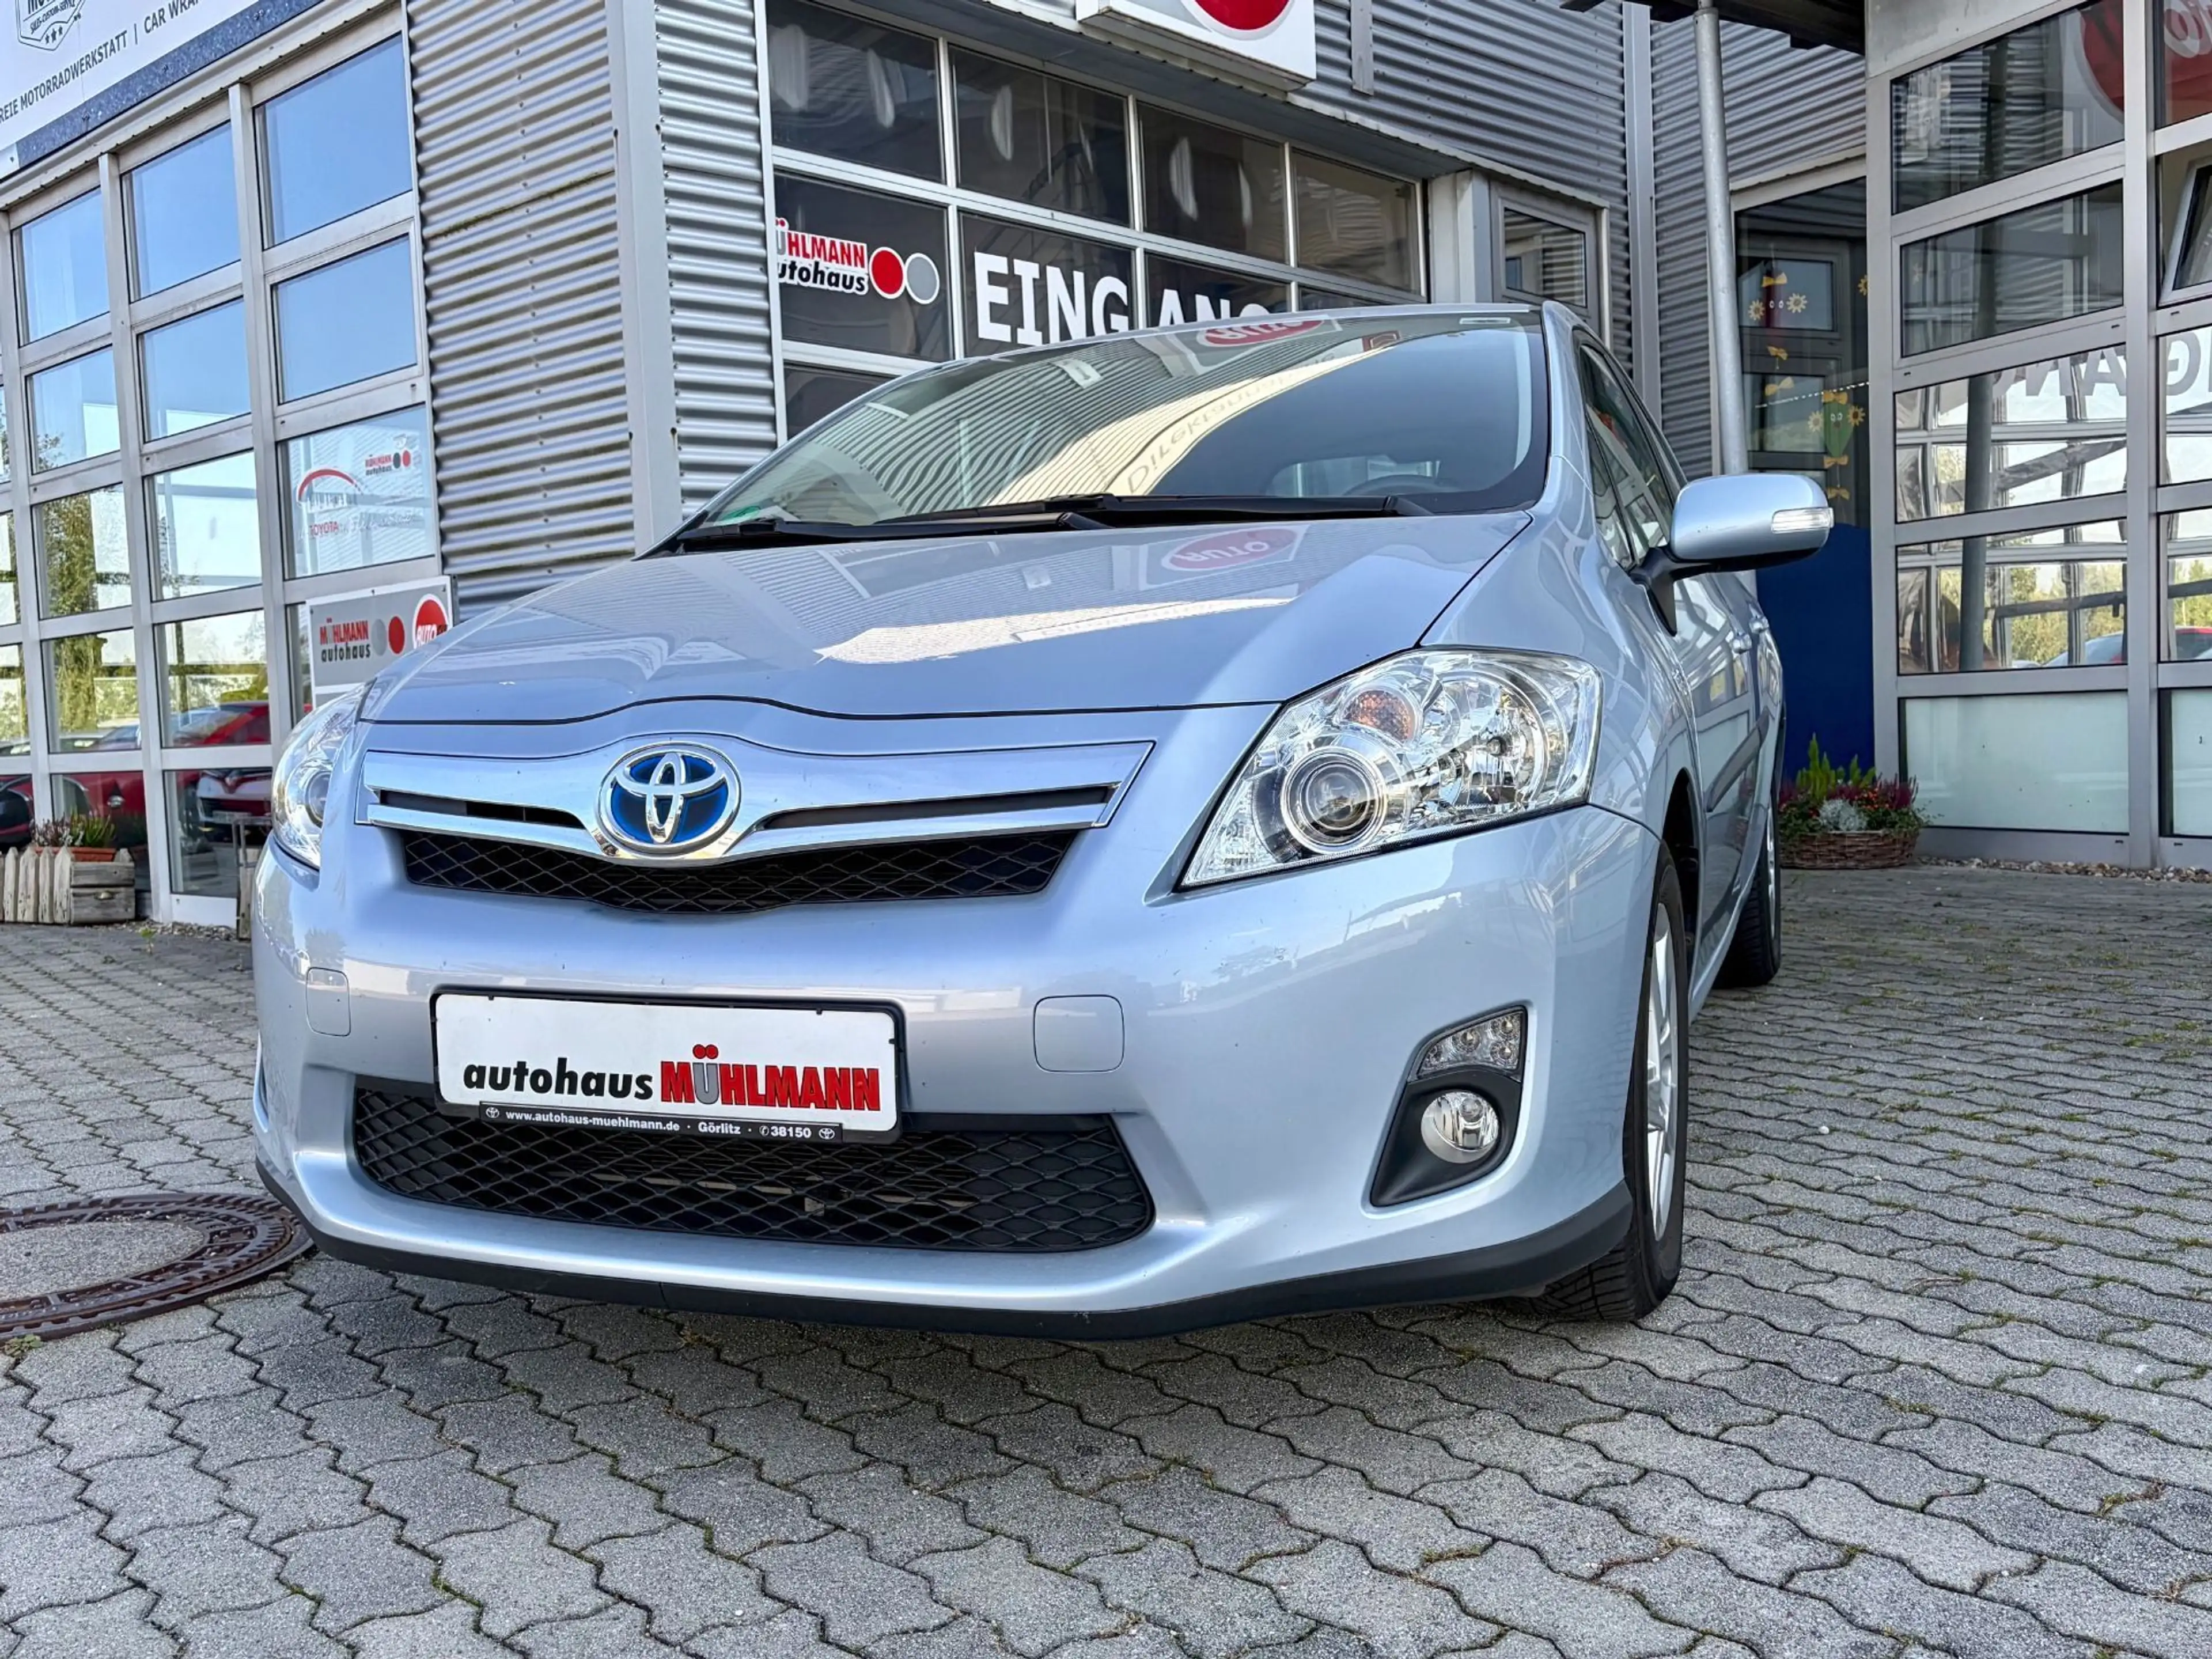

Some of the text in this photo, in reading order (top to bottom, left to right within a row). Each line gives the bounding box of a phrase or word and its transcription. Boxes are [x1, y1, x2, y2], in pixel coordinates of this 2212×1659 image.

[20, 30, 127, 111] MOTORRADWERKSTATT
[144, 7, 166, 34] CAR
[320, 617, 369, 645] MÜHLMANN
[321, 642, 370, 663] autohaus
[463, 1044, 881, 1111] autohaus MÜHLMANN
[505, 1110, 680, 1132] www.autohaus-muehlmann.de
[697, 1121, 741, 1135] Görlitz
